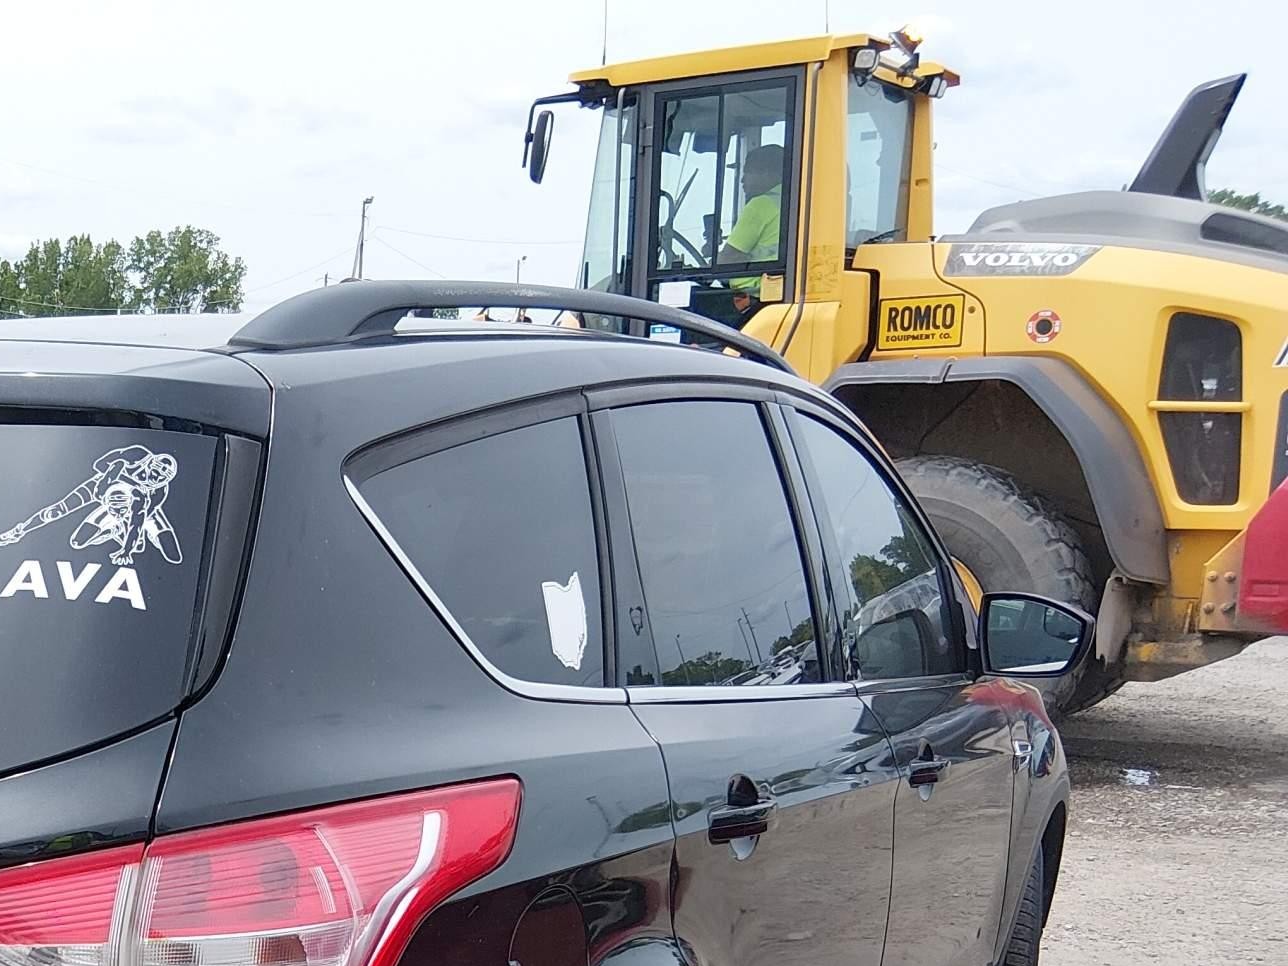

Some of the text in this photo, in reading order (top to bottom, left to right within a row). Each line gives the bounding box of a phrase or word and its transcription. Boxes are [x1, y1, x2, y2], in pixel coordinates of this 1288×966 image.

[959, 252, 1077, 266] VOLVO
[887, 304, 955, 332] ROMCO
[885, 332, 953, 342] EQUIPMENT CO.
[0, 559, 147, 611] AVA
